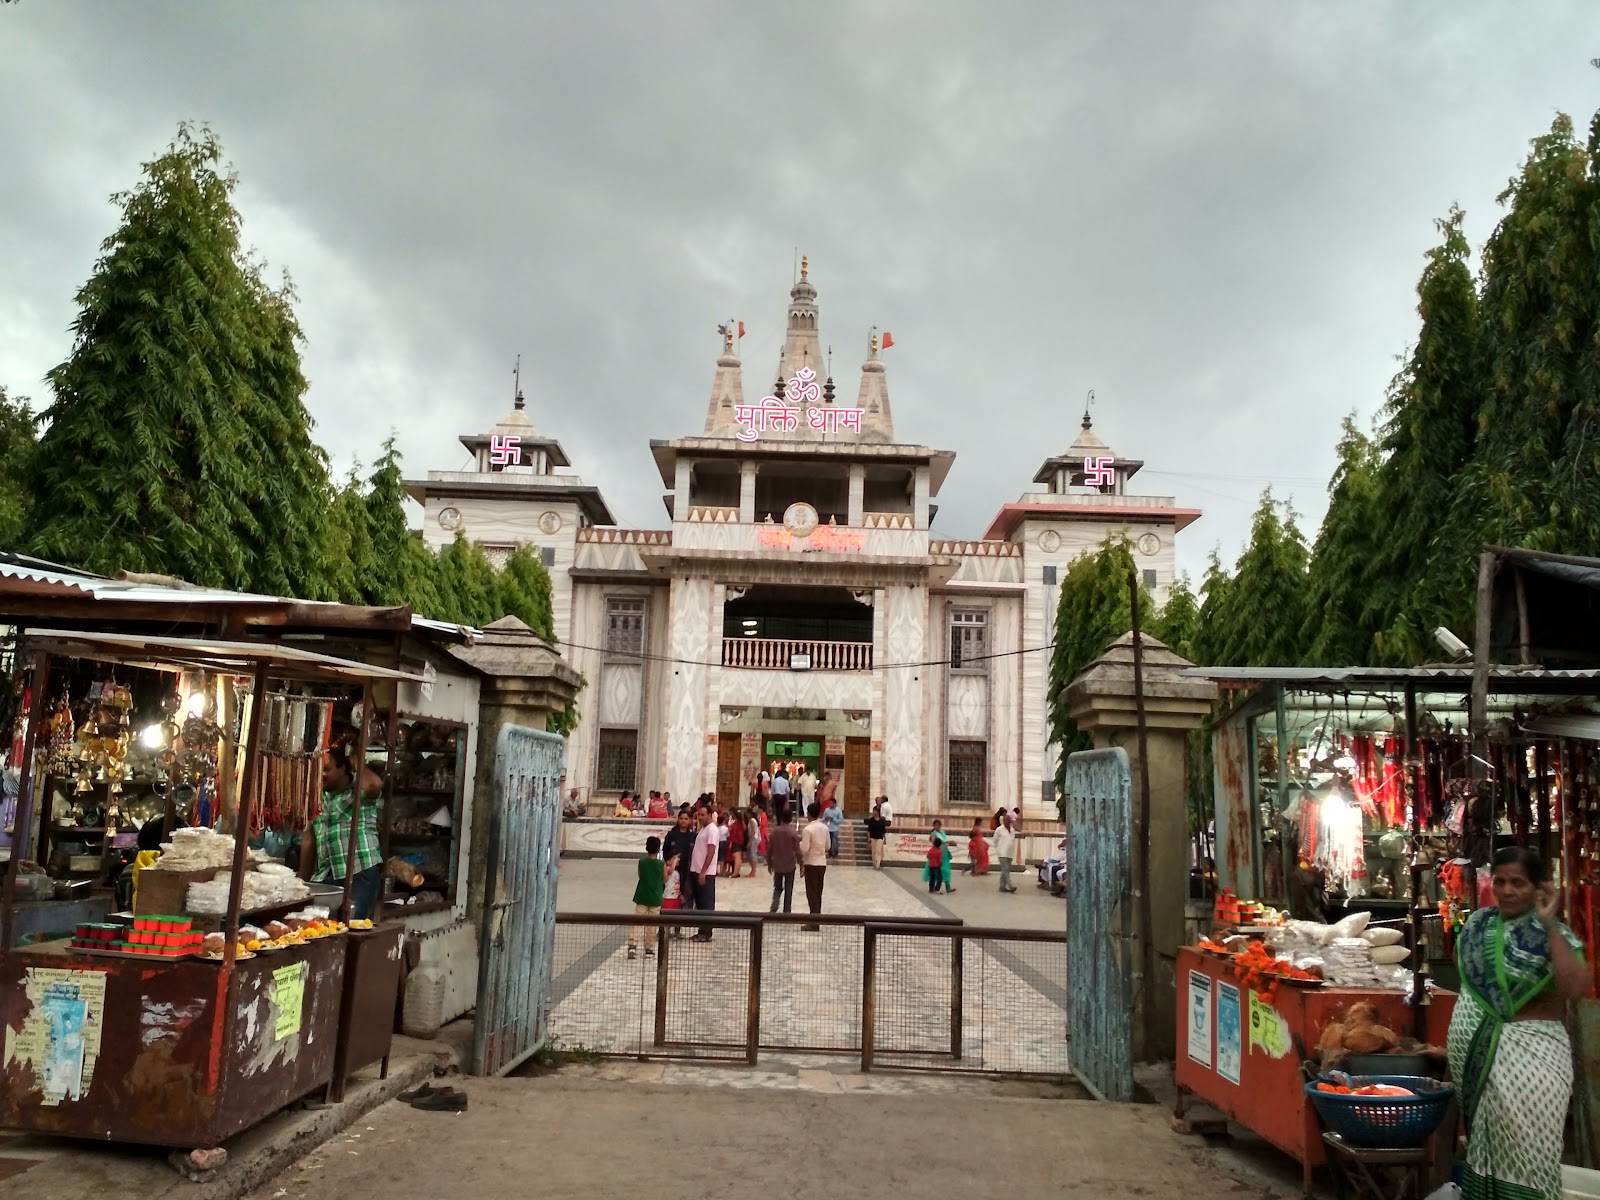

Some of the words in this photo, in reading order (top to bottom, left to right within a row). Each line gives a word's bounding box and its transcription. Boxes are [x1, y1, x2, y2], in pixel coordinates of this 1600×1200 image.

[785, 366, 820, 402] ॐ
[734, 396, 801, 442] मुक्ति
[806, 407, 865, 434] धाम
